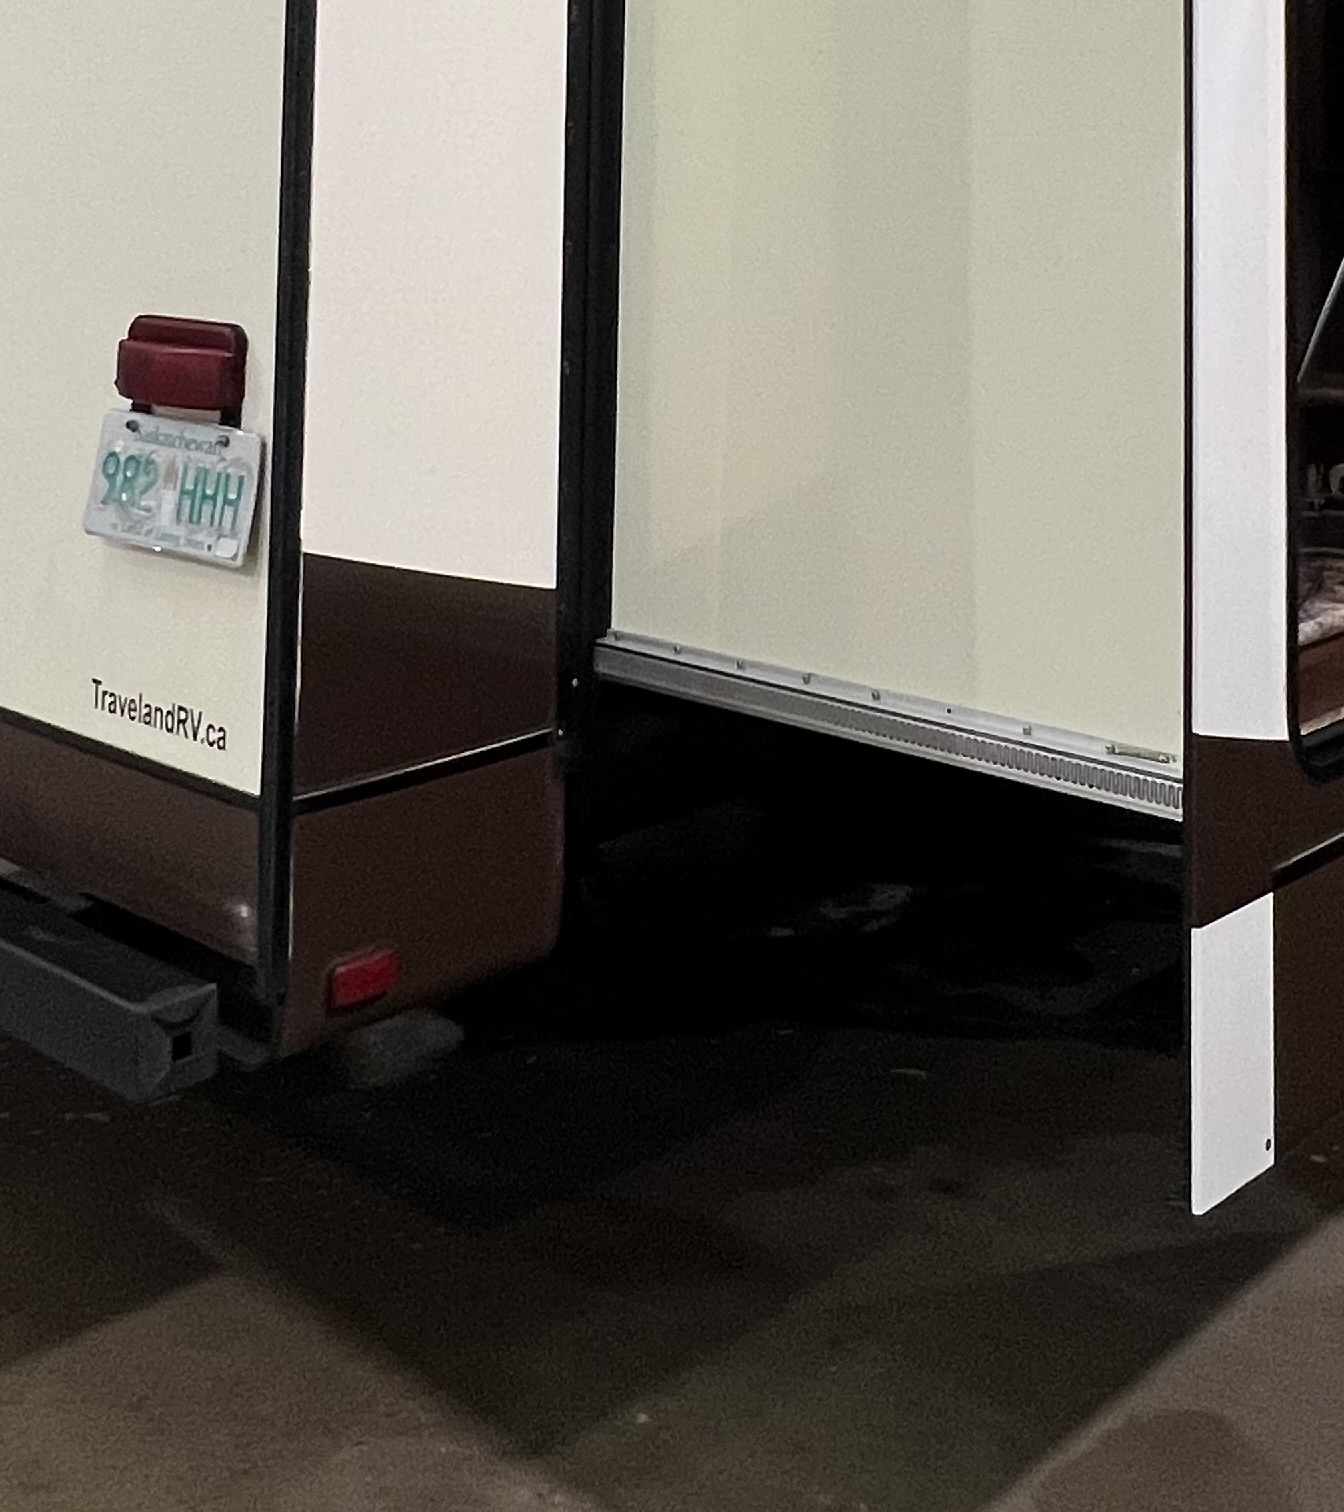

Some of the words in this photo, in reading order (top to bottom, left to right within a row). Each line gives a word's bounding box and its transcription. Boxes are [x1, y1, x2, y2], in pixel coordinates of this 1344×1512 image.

[101, 450, 160, 513] 982
[176, 460, 246, 532] HHH
[91, 678, 227, 751] TravelandRV.ca
